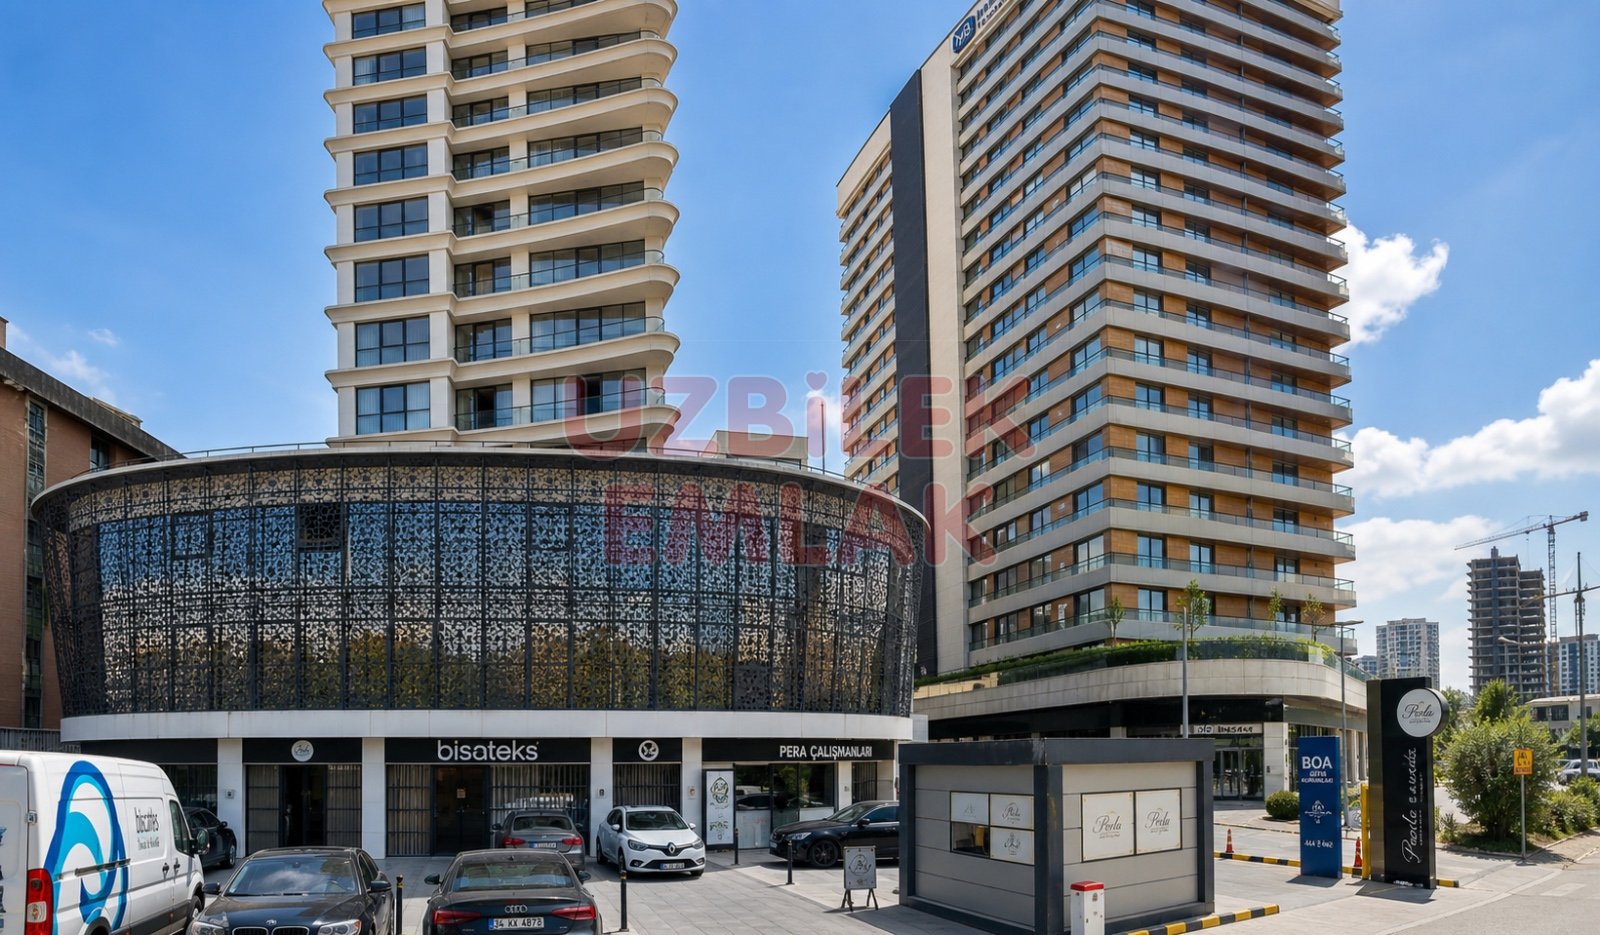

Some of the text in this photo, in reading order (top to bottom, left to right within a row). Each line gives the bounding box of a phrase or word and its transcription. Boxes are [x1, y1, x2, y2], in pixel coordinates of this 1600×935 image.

[437, 739, 538, 761] bisateks
[779, 745, 807, 758] PERA
[1301, 756, 1333, 769] BOA
